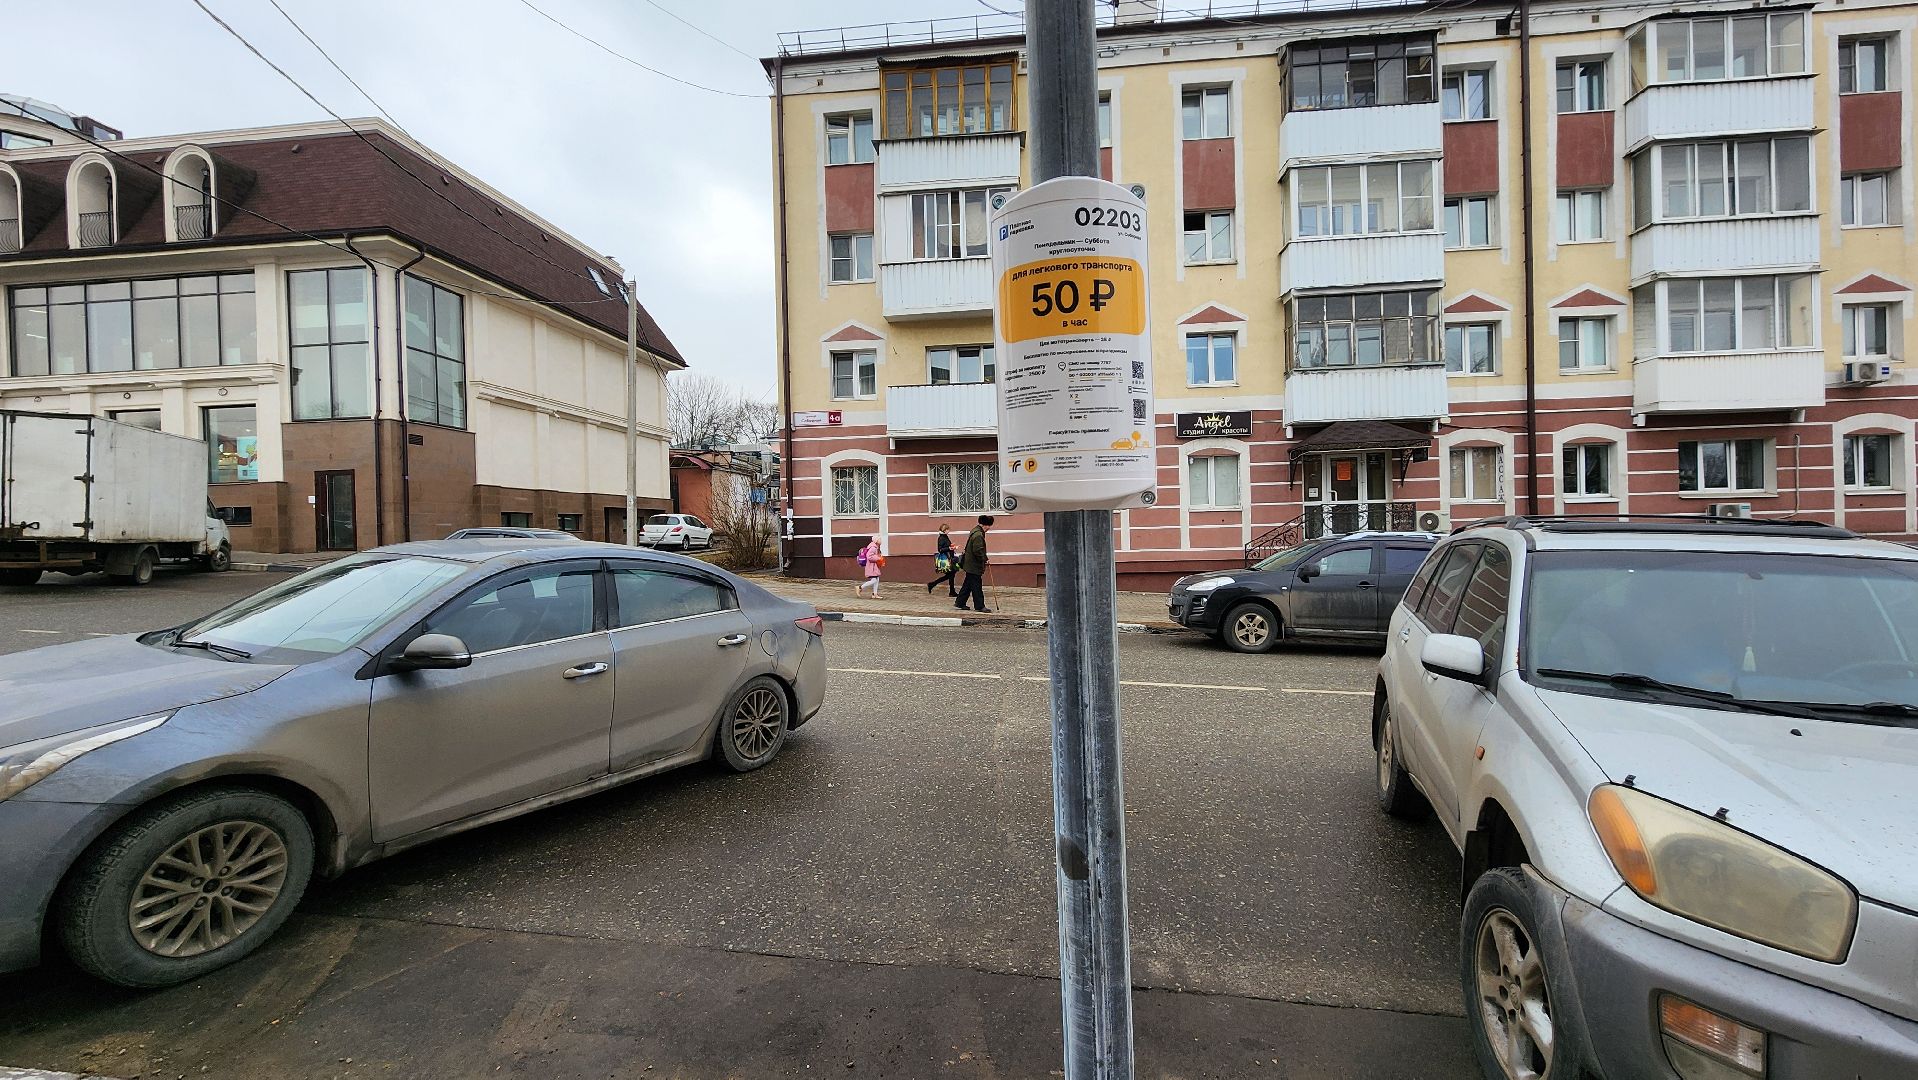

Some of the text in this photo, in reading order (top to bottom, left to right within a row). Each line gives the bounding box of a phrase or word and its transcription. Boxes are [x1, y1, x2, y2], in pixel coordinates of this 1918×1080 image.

[1075, 207, 1141, 232] 02203
[1034, 239, 1076, 250] Понедельник
[1084, 237, 1110, 245] Суббота
[1048, 246, 1096, 256] круглосуточно
[1012, 261, 1133, 282] для легкового транспорта
[1032, 279, 1115, 317] 50 ₽
[1070, 318, 1088, 328] час
[829, 414, 841, 422] 4а
[1193, 414, 1232, 435] Angel
[1497, 445, 1505, 503] МАССАЖ
